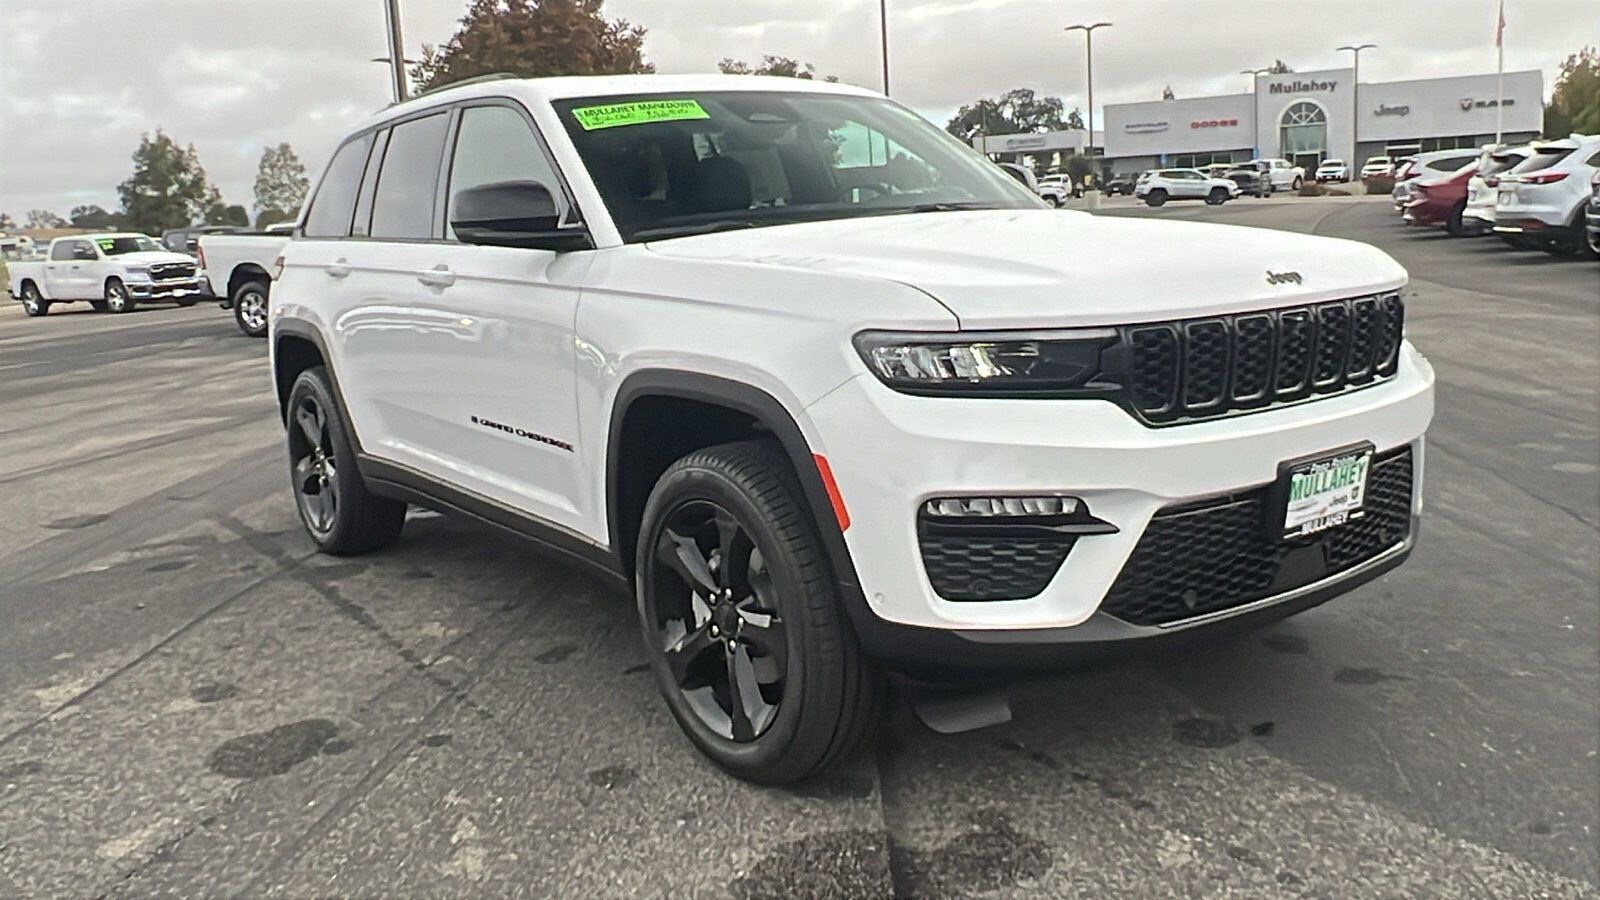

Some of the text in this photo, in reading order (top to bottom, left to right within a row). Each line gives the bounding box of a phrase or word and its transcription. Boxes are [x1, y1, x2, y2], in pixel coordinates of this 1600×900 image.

[1270, 79, 1337, 94] Mullahey
[1374, 104, 1410, 117] Jeep
[1190, 119, 1238, 129] DODGE
[1266, 270, 1303, 286] Jeep
[1291, 462, 1366, 501] MULLAHEY
